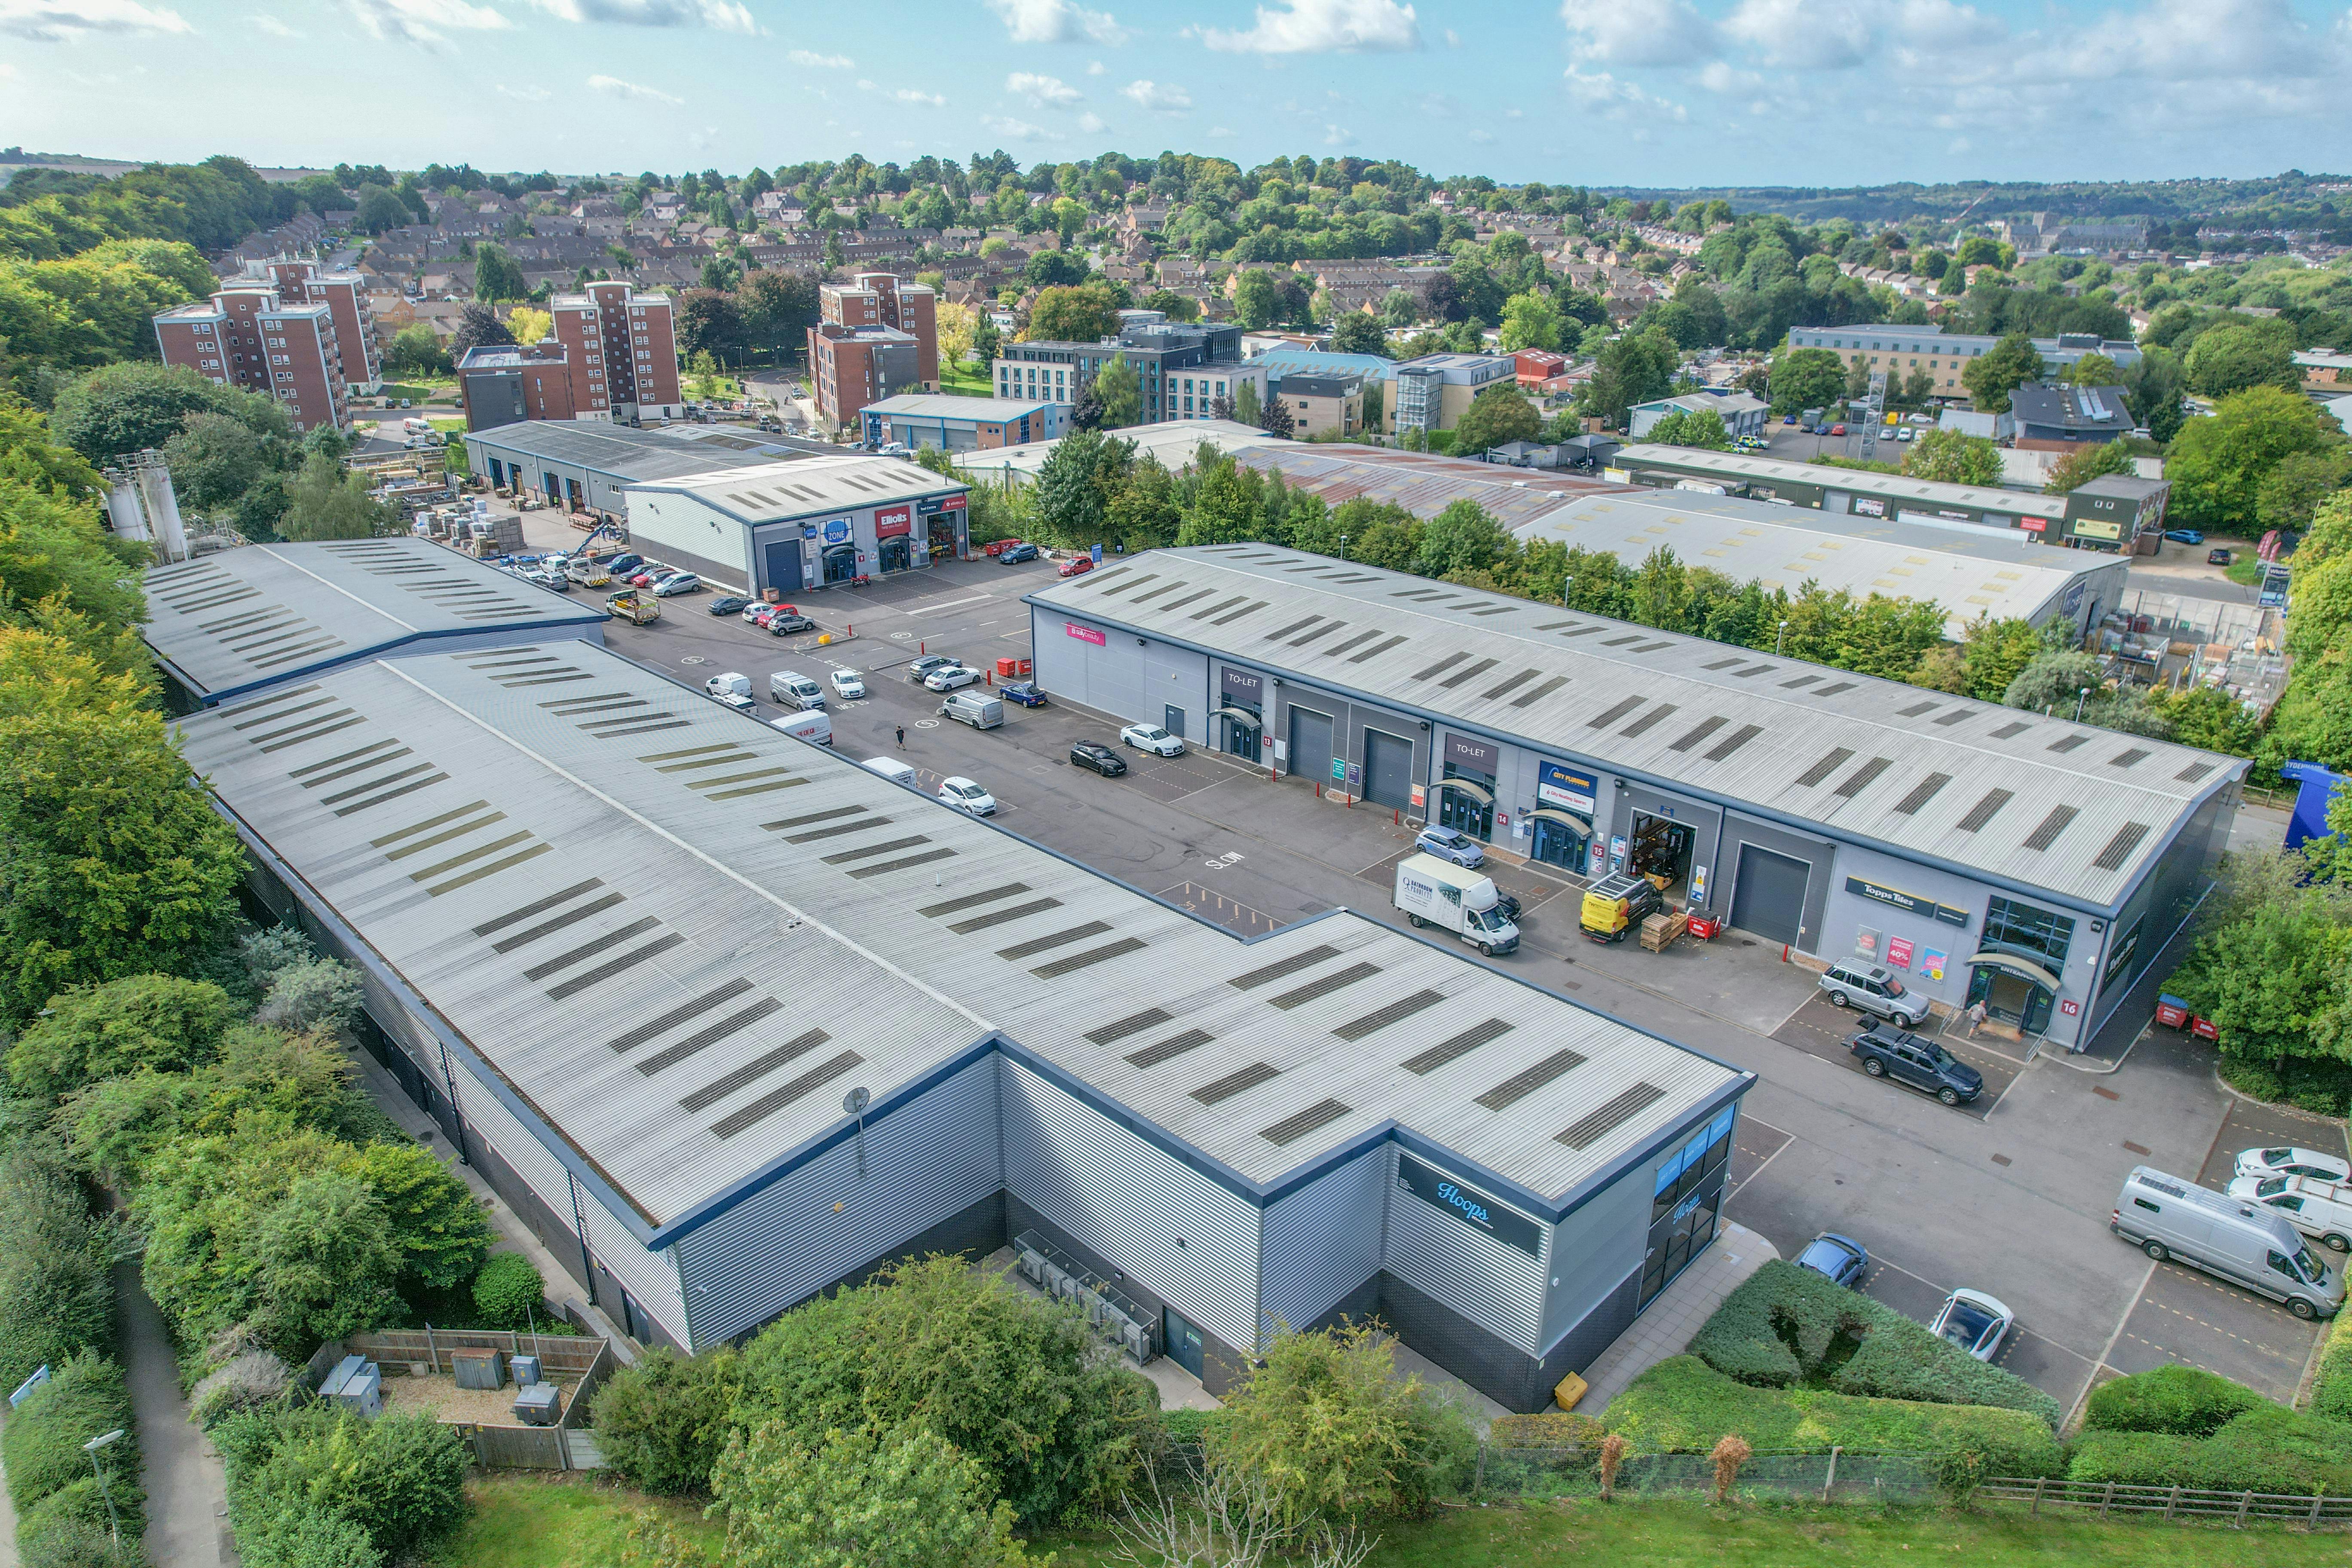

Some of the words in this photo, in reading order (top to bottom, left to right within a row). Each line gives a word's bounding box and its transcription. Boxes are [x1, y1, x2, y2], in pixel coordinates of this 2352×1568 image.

[828, 531, 845, 540] ZONE
[1229, 674, 1257, 687] TO-LET
[835, 700, 869, 710] SLOW
[1457, 744, 1485, 757] TO-LET
[1565, 775, 1589, 787] PLUMBING
[1559, 793, 1573, 802] Heating
[1499, 815, 1506, 824] 14
[1594, 847, 1603, 855] 15
[1205, 851, 1245, 869] SLOW
[1411, 880, 1433, 893] BATHROOM
[1411, 885, 1432, 900] PRODUCTS
[1864, 884, 1893, 899] Topps
[1893, 893, 1914, 906] Tiles
[1890, 950, 1908, 960] 40%
[2064, 1003, 2076, 1014] 16
[1438, 1182, 1489, 1220] Hoops
[1673, 1193, 1701, 1225] Hoops
[1471, 1215, 1494, 1229] Winchester
